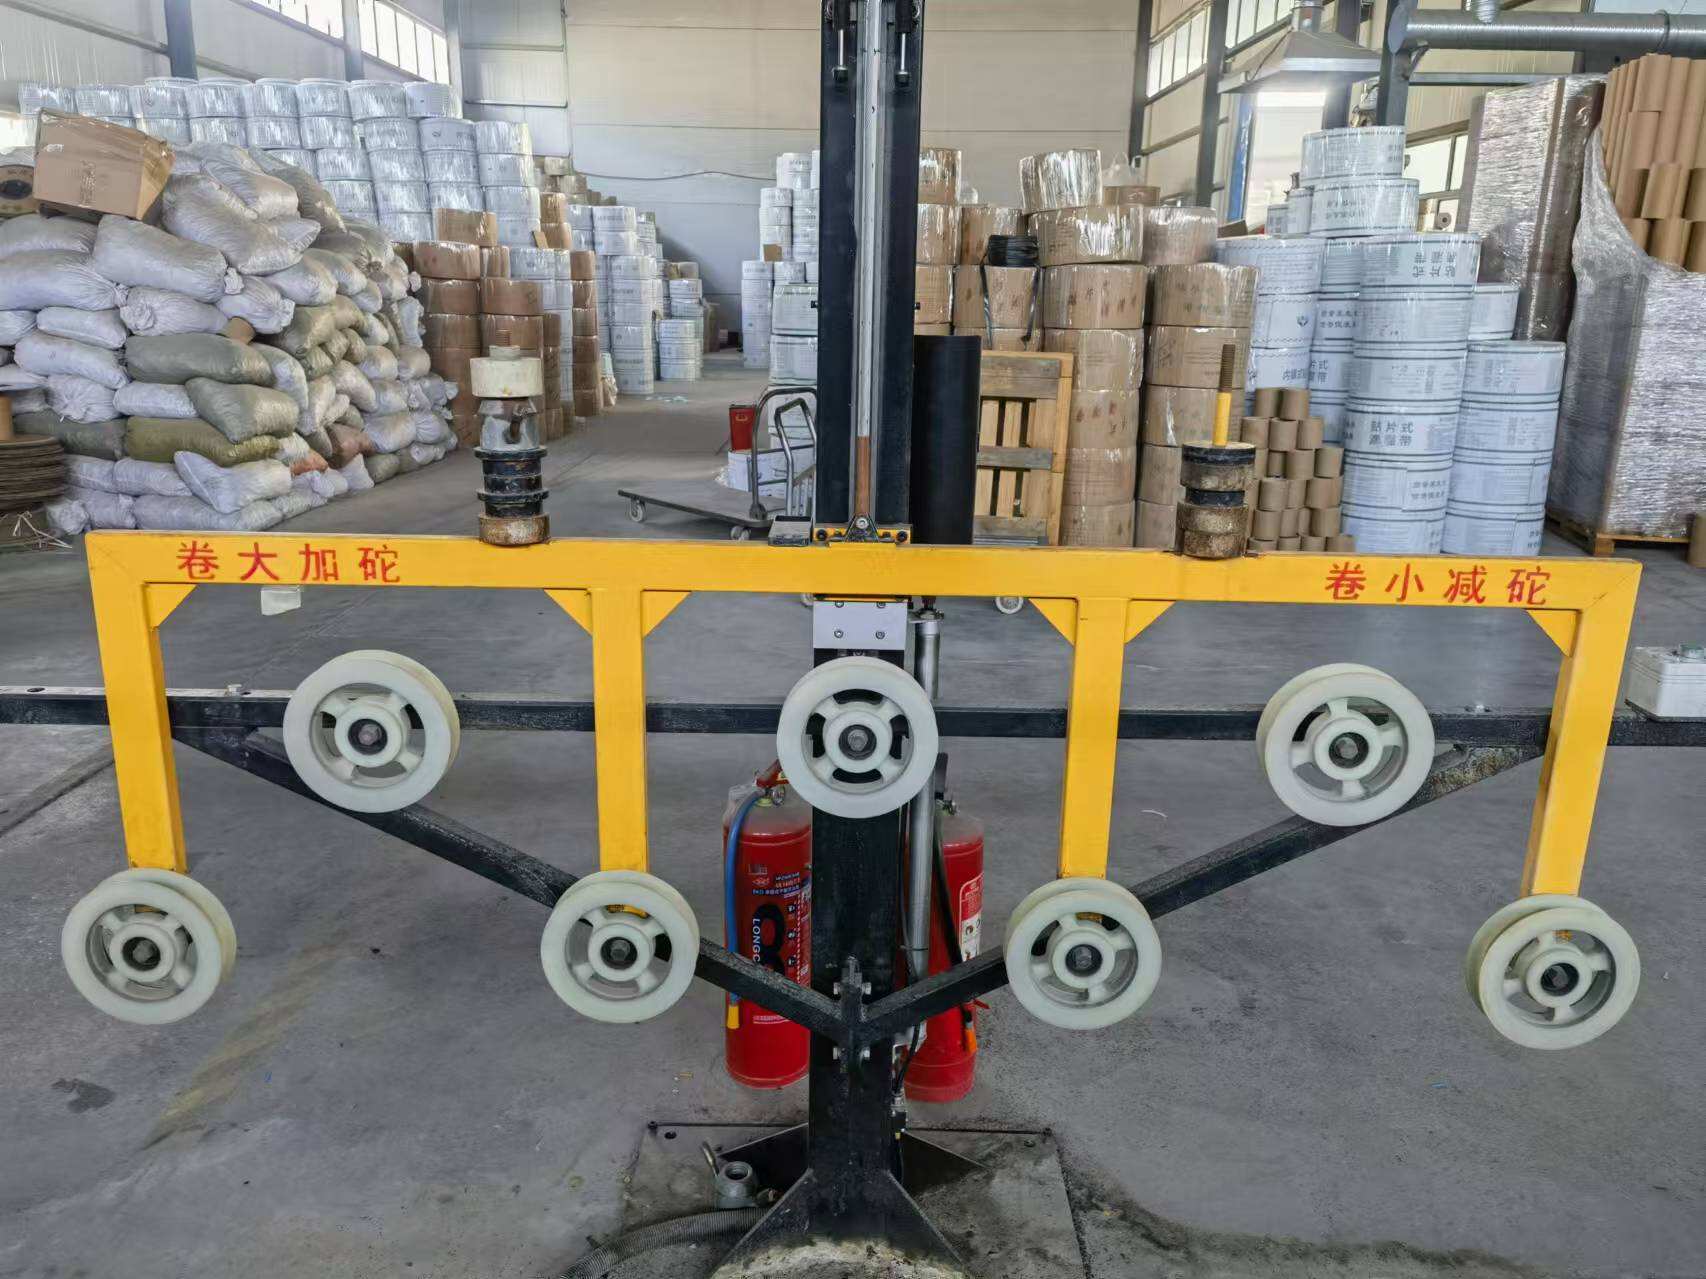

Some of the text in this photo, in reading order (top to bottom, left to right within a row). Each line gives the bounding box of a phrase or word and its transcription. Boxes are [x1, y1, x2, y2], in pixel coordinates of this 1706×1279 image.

[176, 540, 400, 583] 卷大加砣
[1325, 561, 1550, 605] 卷小减砣
